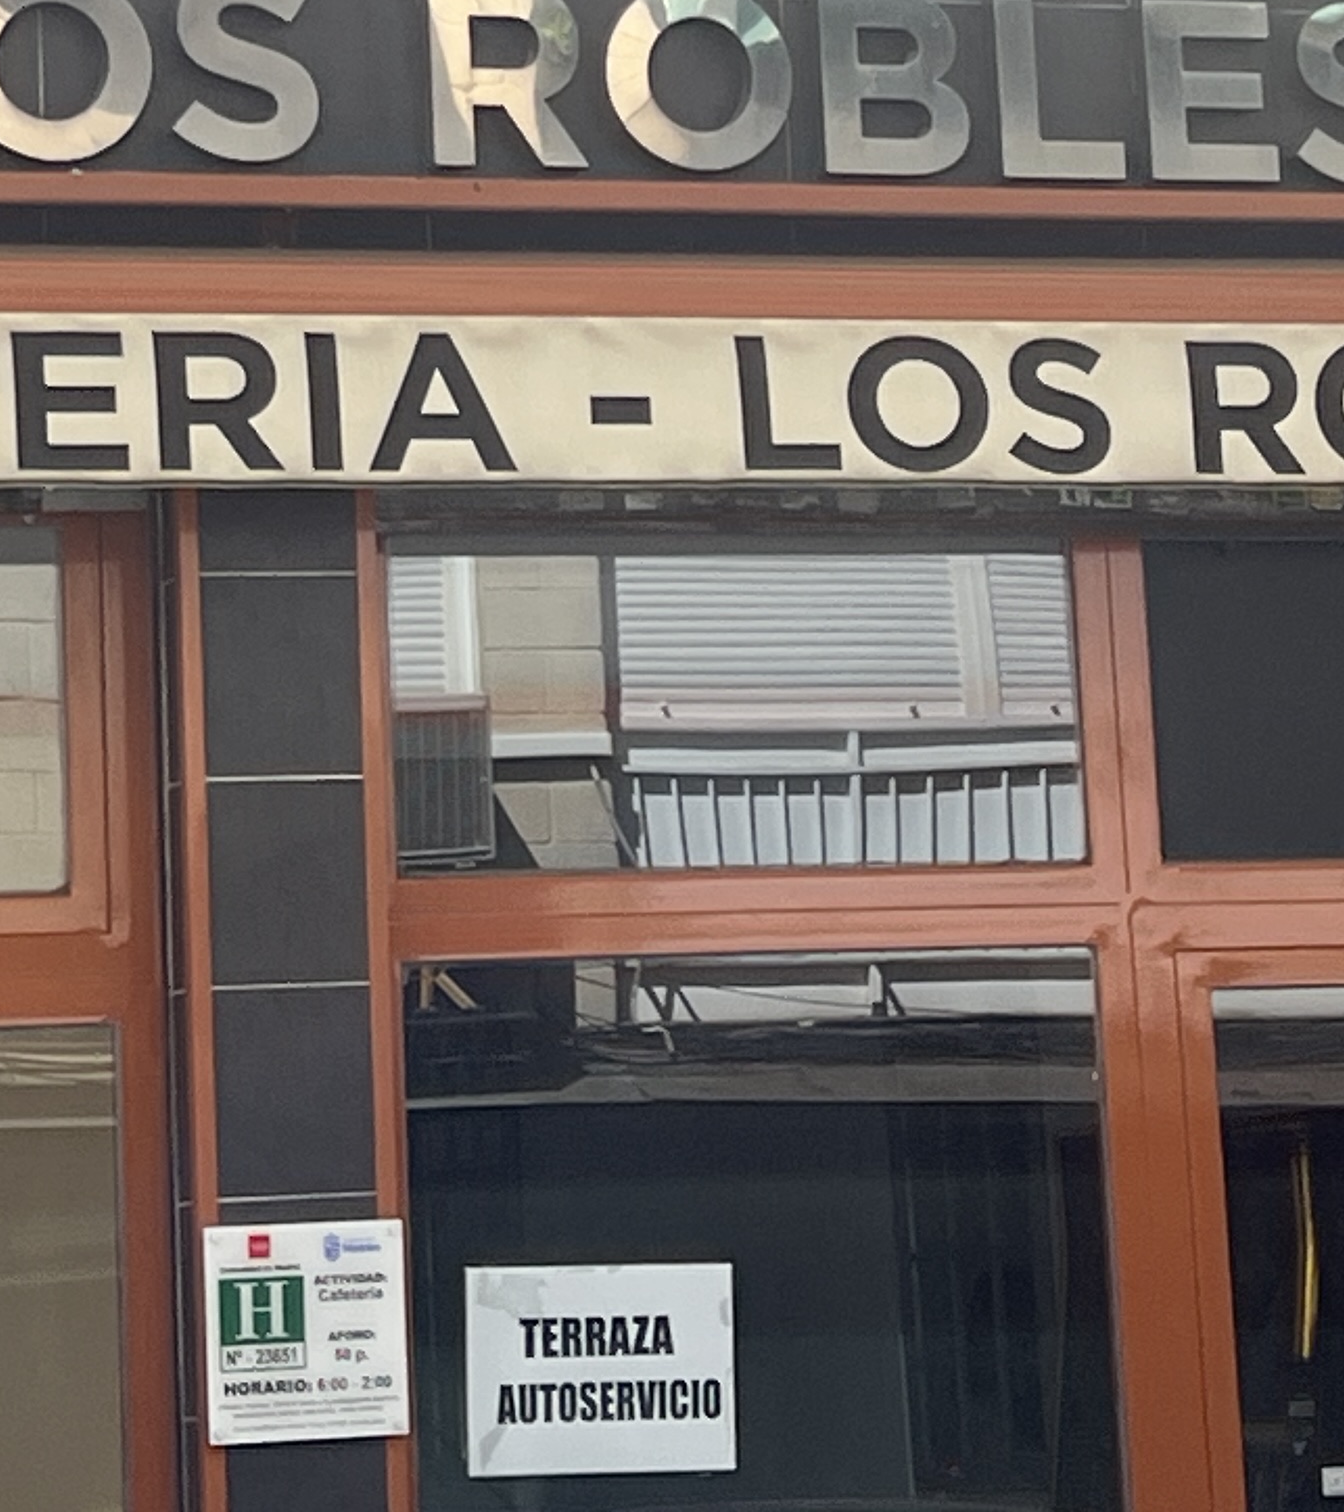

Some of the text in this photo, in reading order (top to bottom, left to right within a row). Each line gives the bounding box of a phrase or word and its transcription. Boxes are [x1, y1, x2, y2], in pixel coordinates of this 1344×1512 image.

[590, 395, 653, 425] -
[733, 335, 1112, 475] LOS
[233, 1279, 290, 1340] H
[518, 1315, 675, 1359] TERRAZA
[224, 1379, 313, 1397] HORARIO:
[497, 1378, 722, 1425] AUTOSERVICIO
